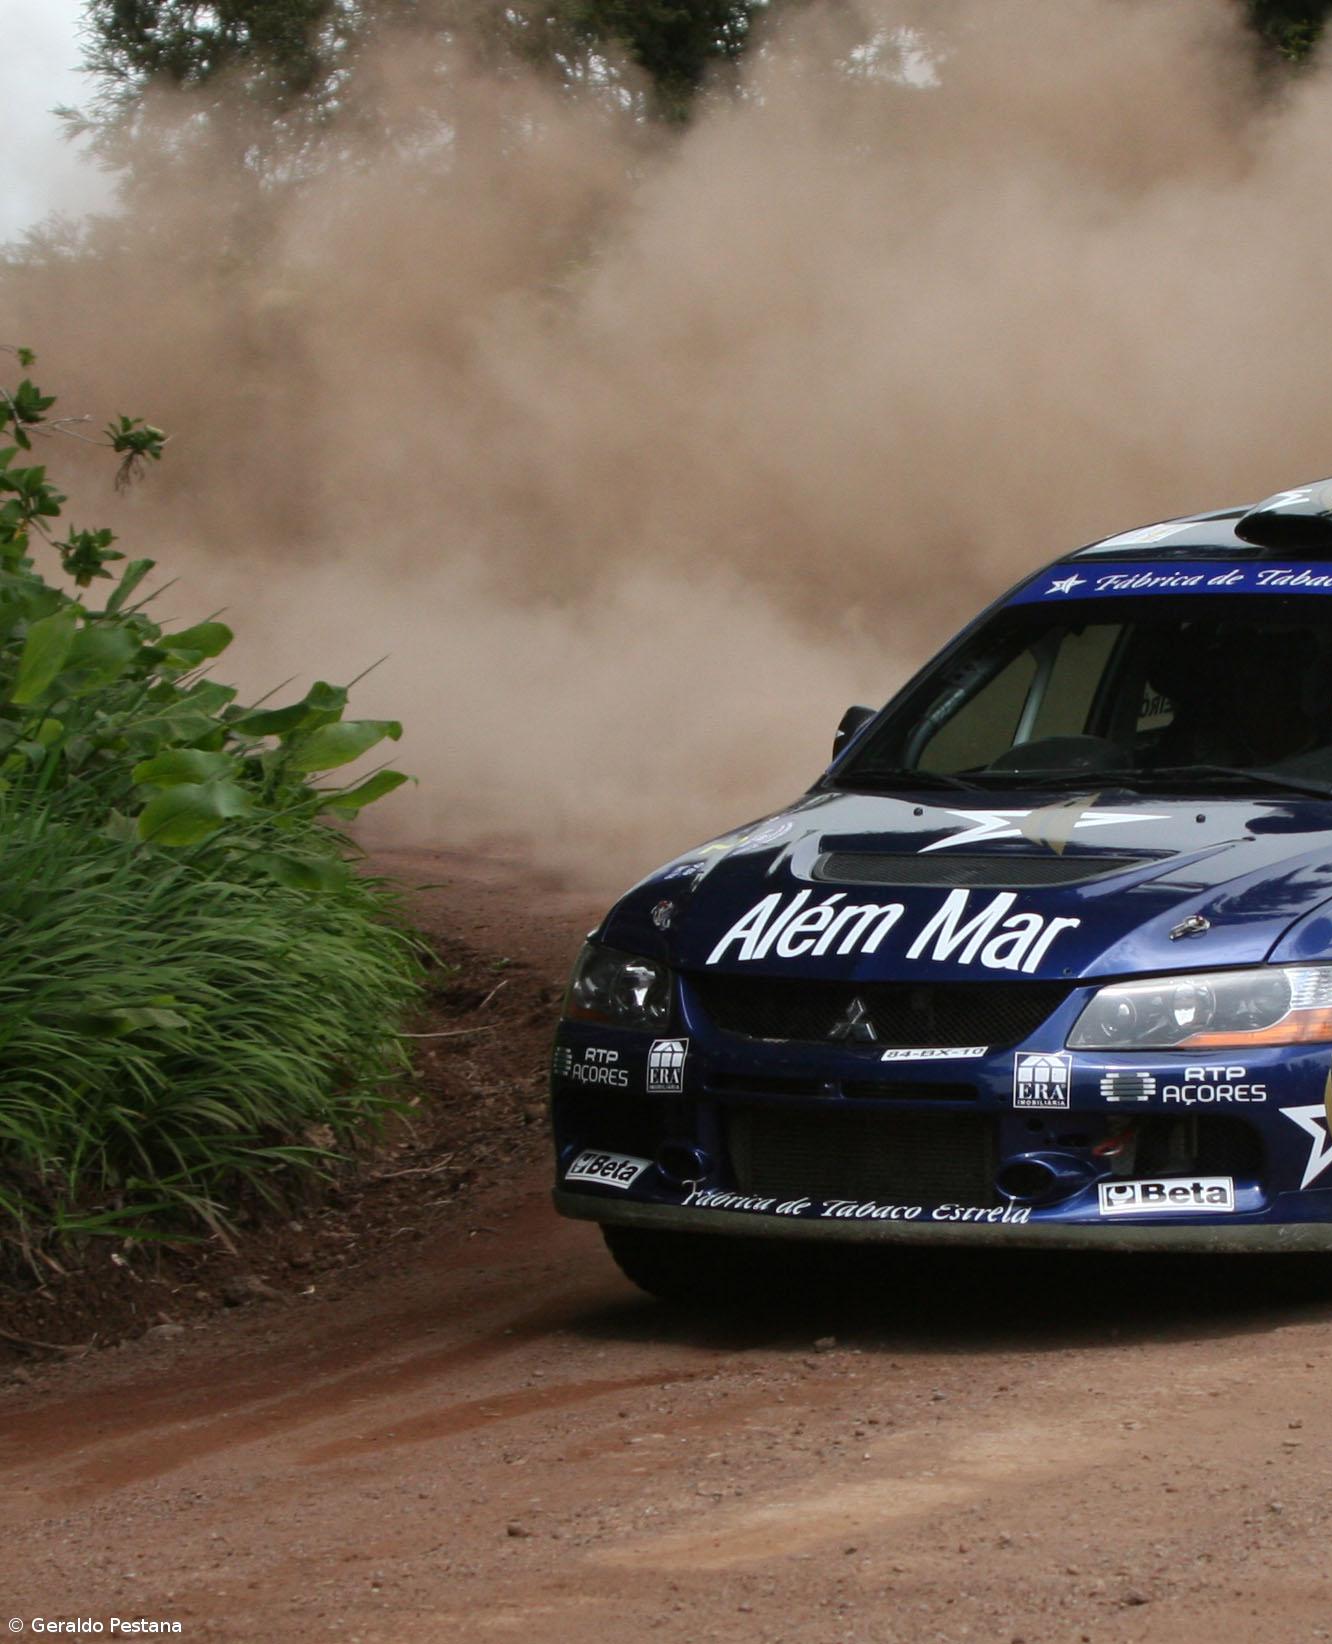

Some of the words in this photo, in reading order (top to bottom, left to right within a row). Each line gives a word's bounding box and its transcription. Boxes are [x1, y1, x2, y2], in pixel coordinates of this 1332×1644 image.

[1094, 571, 1204, 592] Fábrica
[1207, 569, 1244, 587] de
[705, 889, 905, 965] Além
[905, 888, 1081, 974] Mar
[584, 1048, 619, 1063] RTP
[572, 1064, 629, 1087] AÇORES
[650, 1068, 680, 1084] ERA
[1184, 1066, 1247, 1082] RTP
[1018, 1083, 1065, 1100] ERA
[1162, 1084, 1267, 1105] AÇORES
[585, 1155, 639, 1181] Beta
[1140, 1182, 1228, 1204] Beta
[775, 1197, 812, 1215] de
[820, 1200, 923, 1220] Tabaco
[931, 1199, 1032, 1225] Estrela
